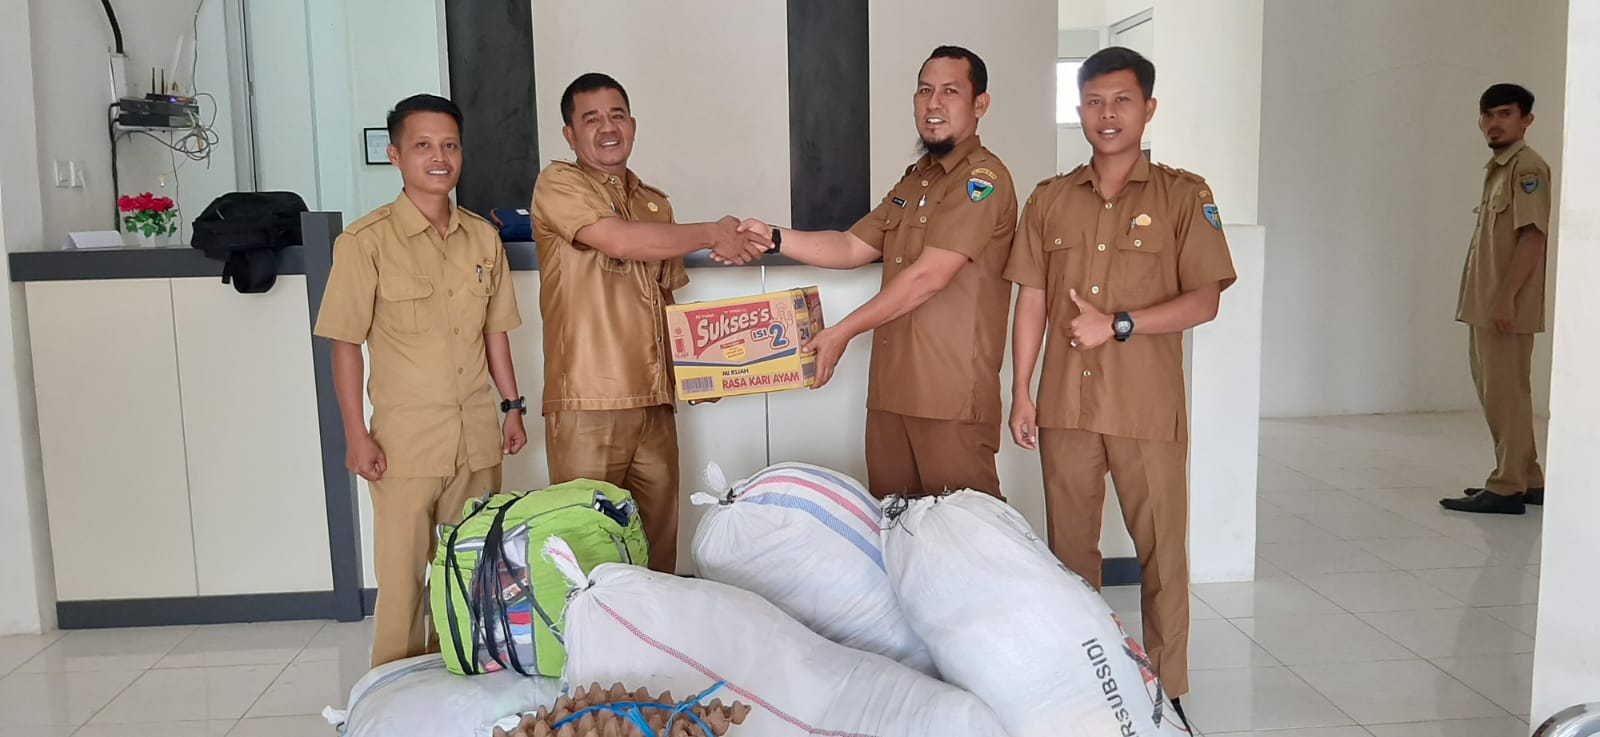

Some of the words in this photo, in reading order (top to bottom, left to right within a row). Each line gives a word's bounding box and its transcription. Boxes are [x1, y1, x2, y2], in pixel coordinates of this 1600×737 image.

[697, 308, 770, 348] Sukses's
[753, 329, 767, 339] ISI
[770, 323, 787, 347] 2
[722, 377, 747, 389] RASA
[749, 375, 771, 387] KARI
[773, 372, 800, 383] AYAM
